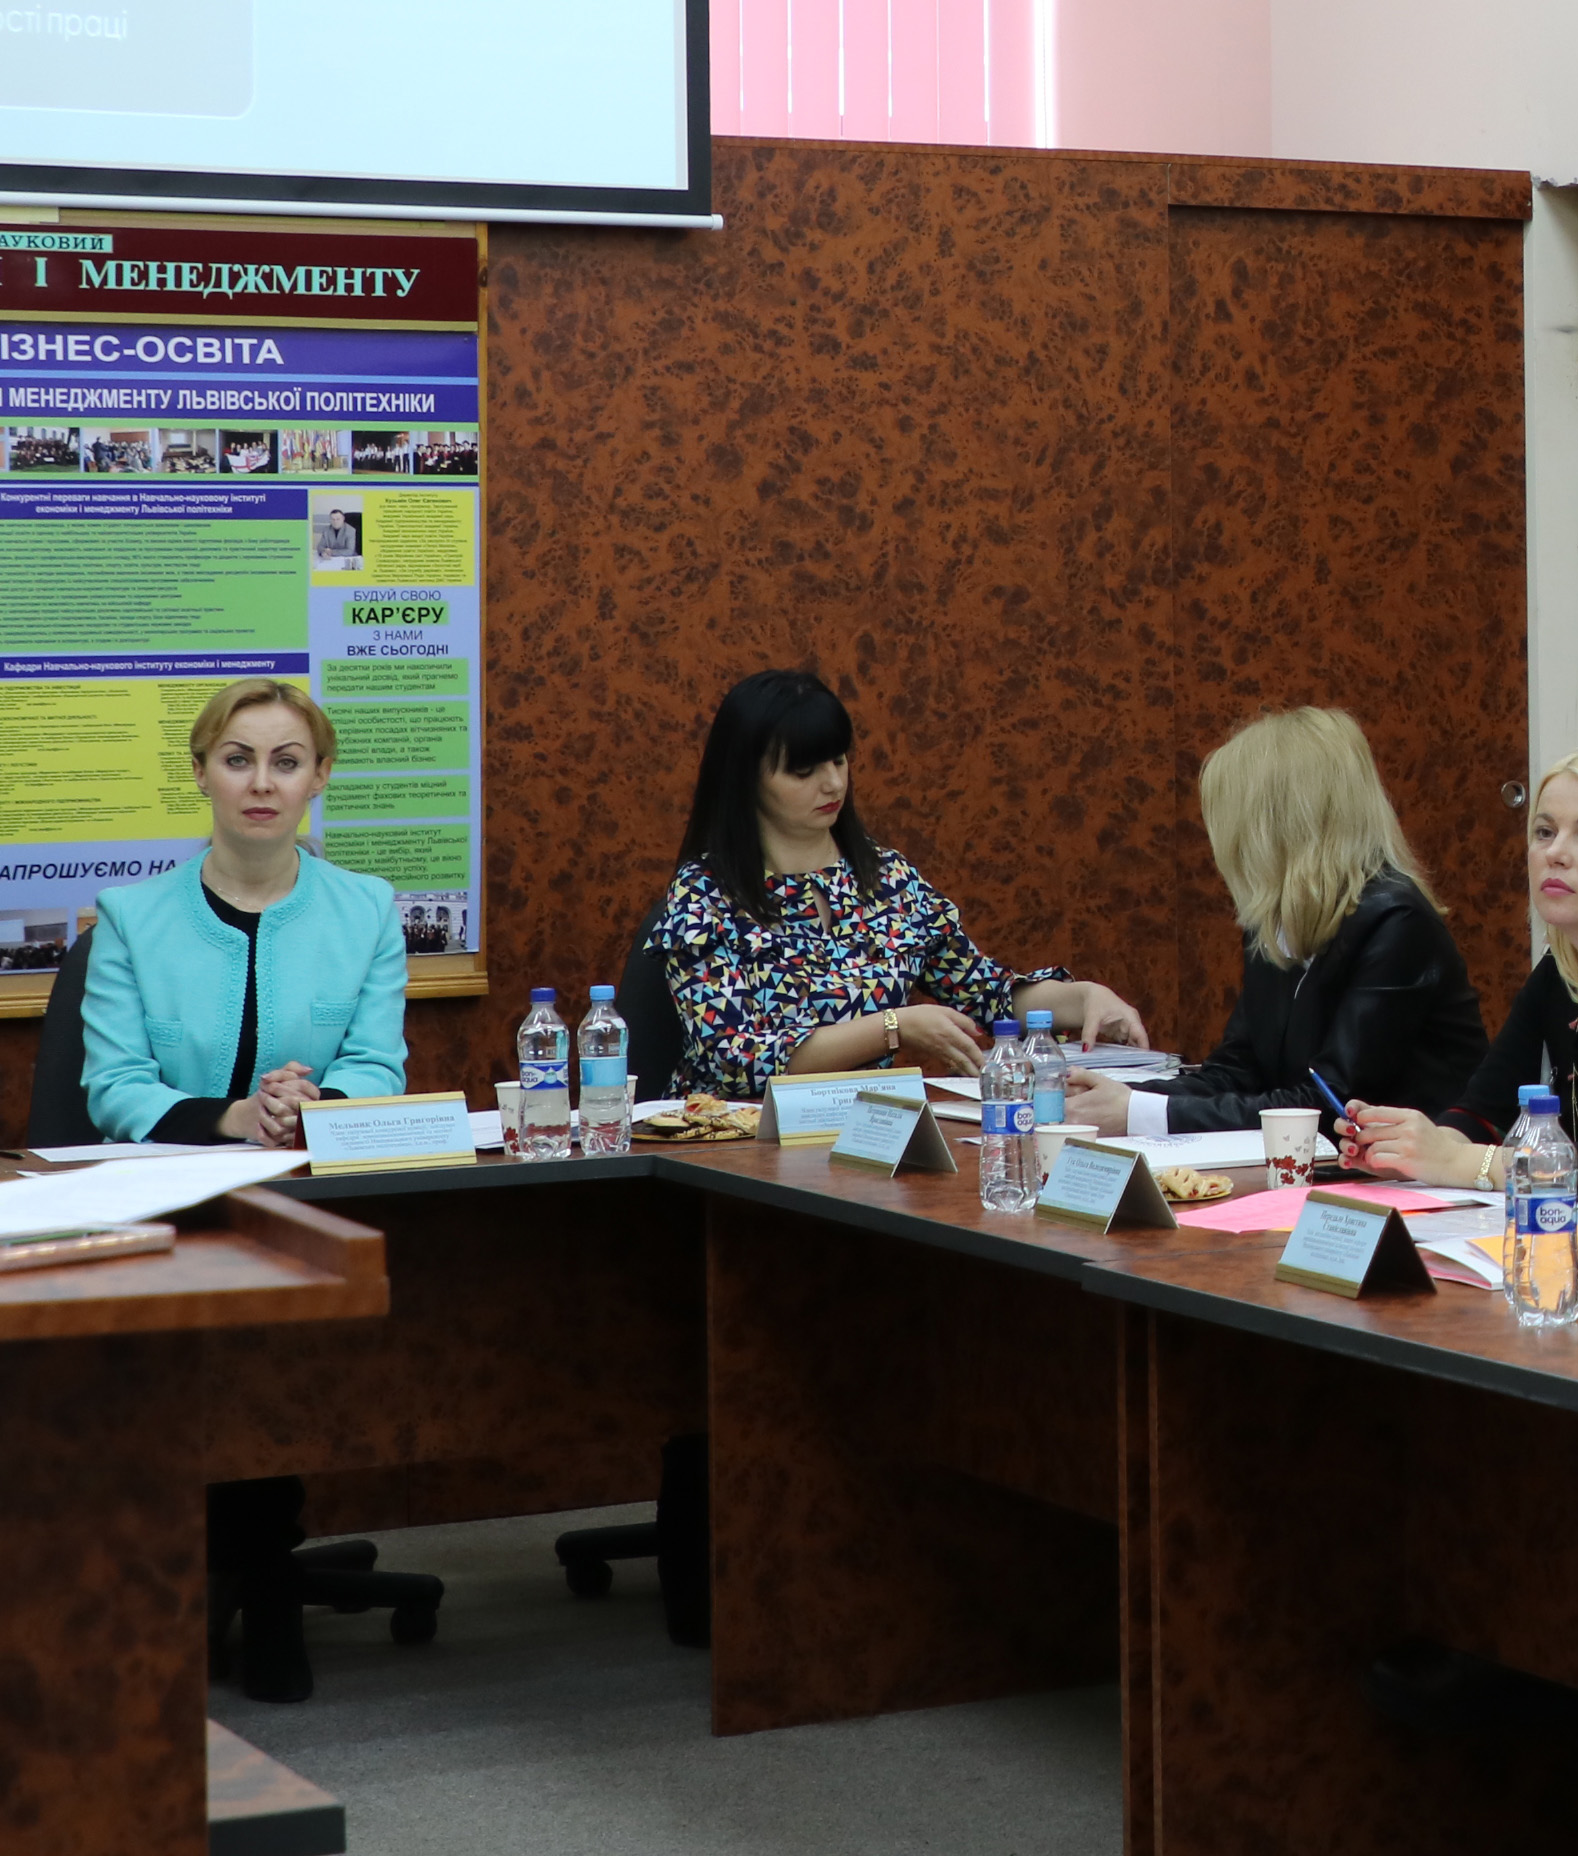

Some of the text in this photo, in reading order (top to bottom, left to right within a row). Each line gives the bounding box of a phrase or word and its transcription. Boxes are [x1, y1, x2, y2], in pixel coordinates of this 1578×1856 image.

[0, 4, 127, 41] сті праці
[78, 259, 421, 300] МЕНЕДЖМЕНТУ
[9, 386, 435, 413] МЕНЕДЖМЕНТУ ЛЬВІВСЬКОЇ ПОЛІТЕХНІКИ
[353, 589, 442, 603] БУДУЙ СВОЮ
[351, 607, 444, 624] КАР’ЄРУ
[372, 630, 423, 641] З НАМИ
[347, 644, 449, 657] ВЖЕ СЬОГОДНІ
[4, 662, 42, 673] Кафедри
[43, 661, 133, 672] Навчально-наукового
[134, 661, 173, 671] інституту
[174, 660, 215, 669] економіки
[221, 660, 276, 670] менеджменту
[327, 664, 337, 672] За
[372, 664, 392, 672] років
[331, 717, 357, 725] спішні
[0, 860, 143, 880] АПРОШУЄМО
[810, 1087, 859, 1097] Бортнікова
[328, 1113, 455, 1131] Мельник Ольга Григорівна
[1540, 1206, 1563, 1216] bon-
[1540, 1215, 1566, 1226] aqua
